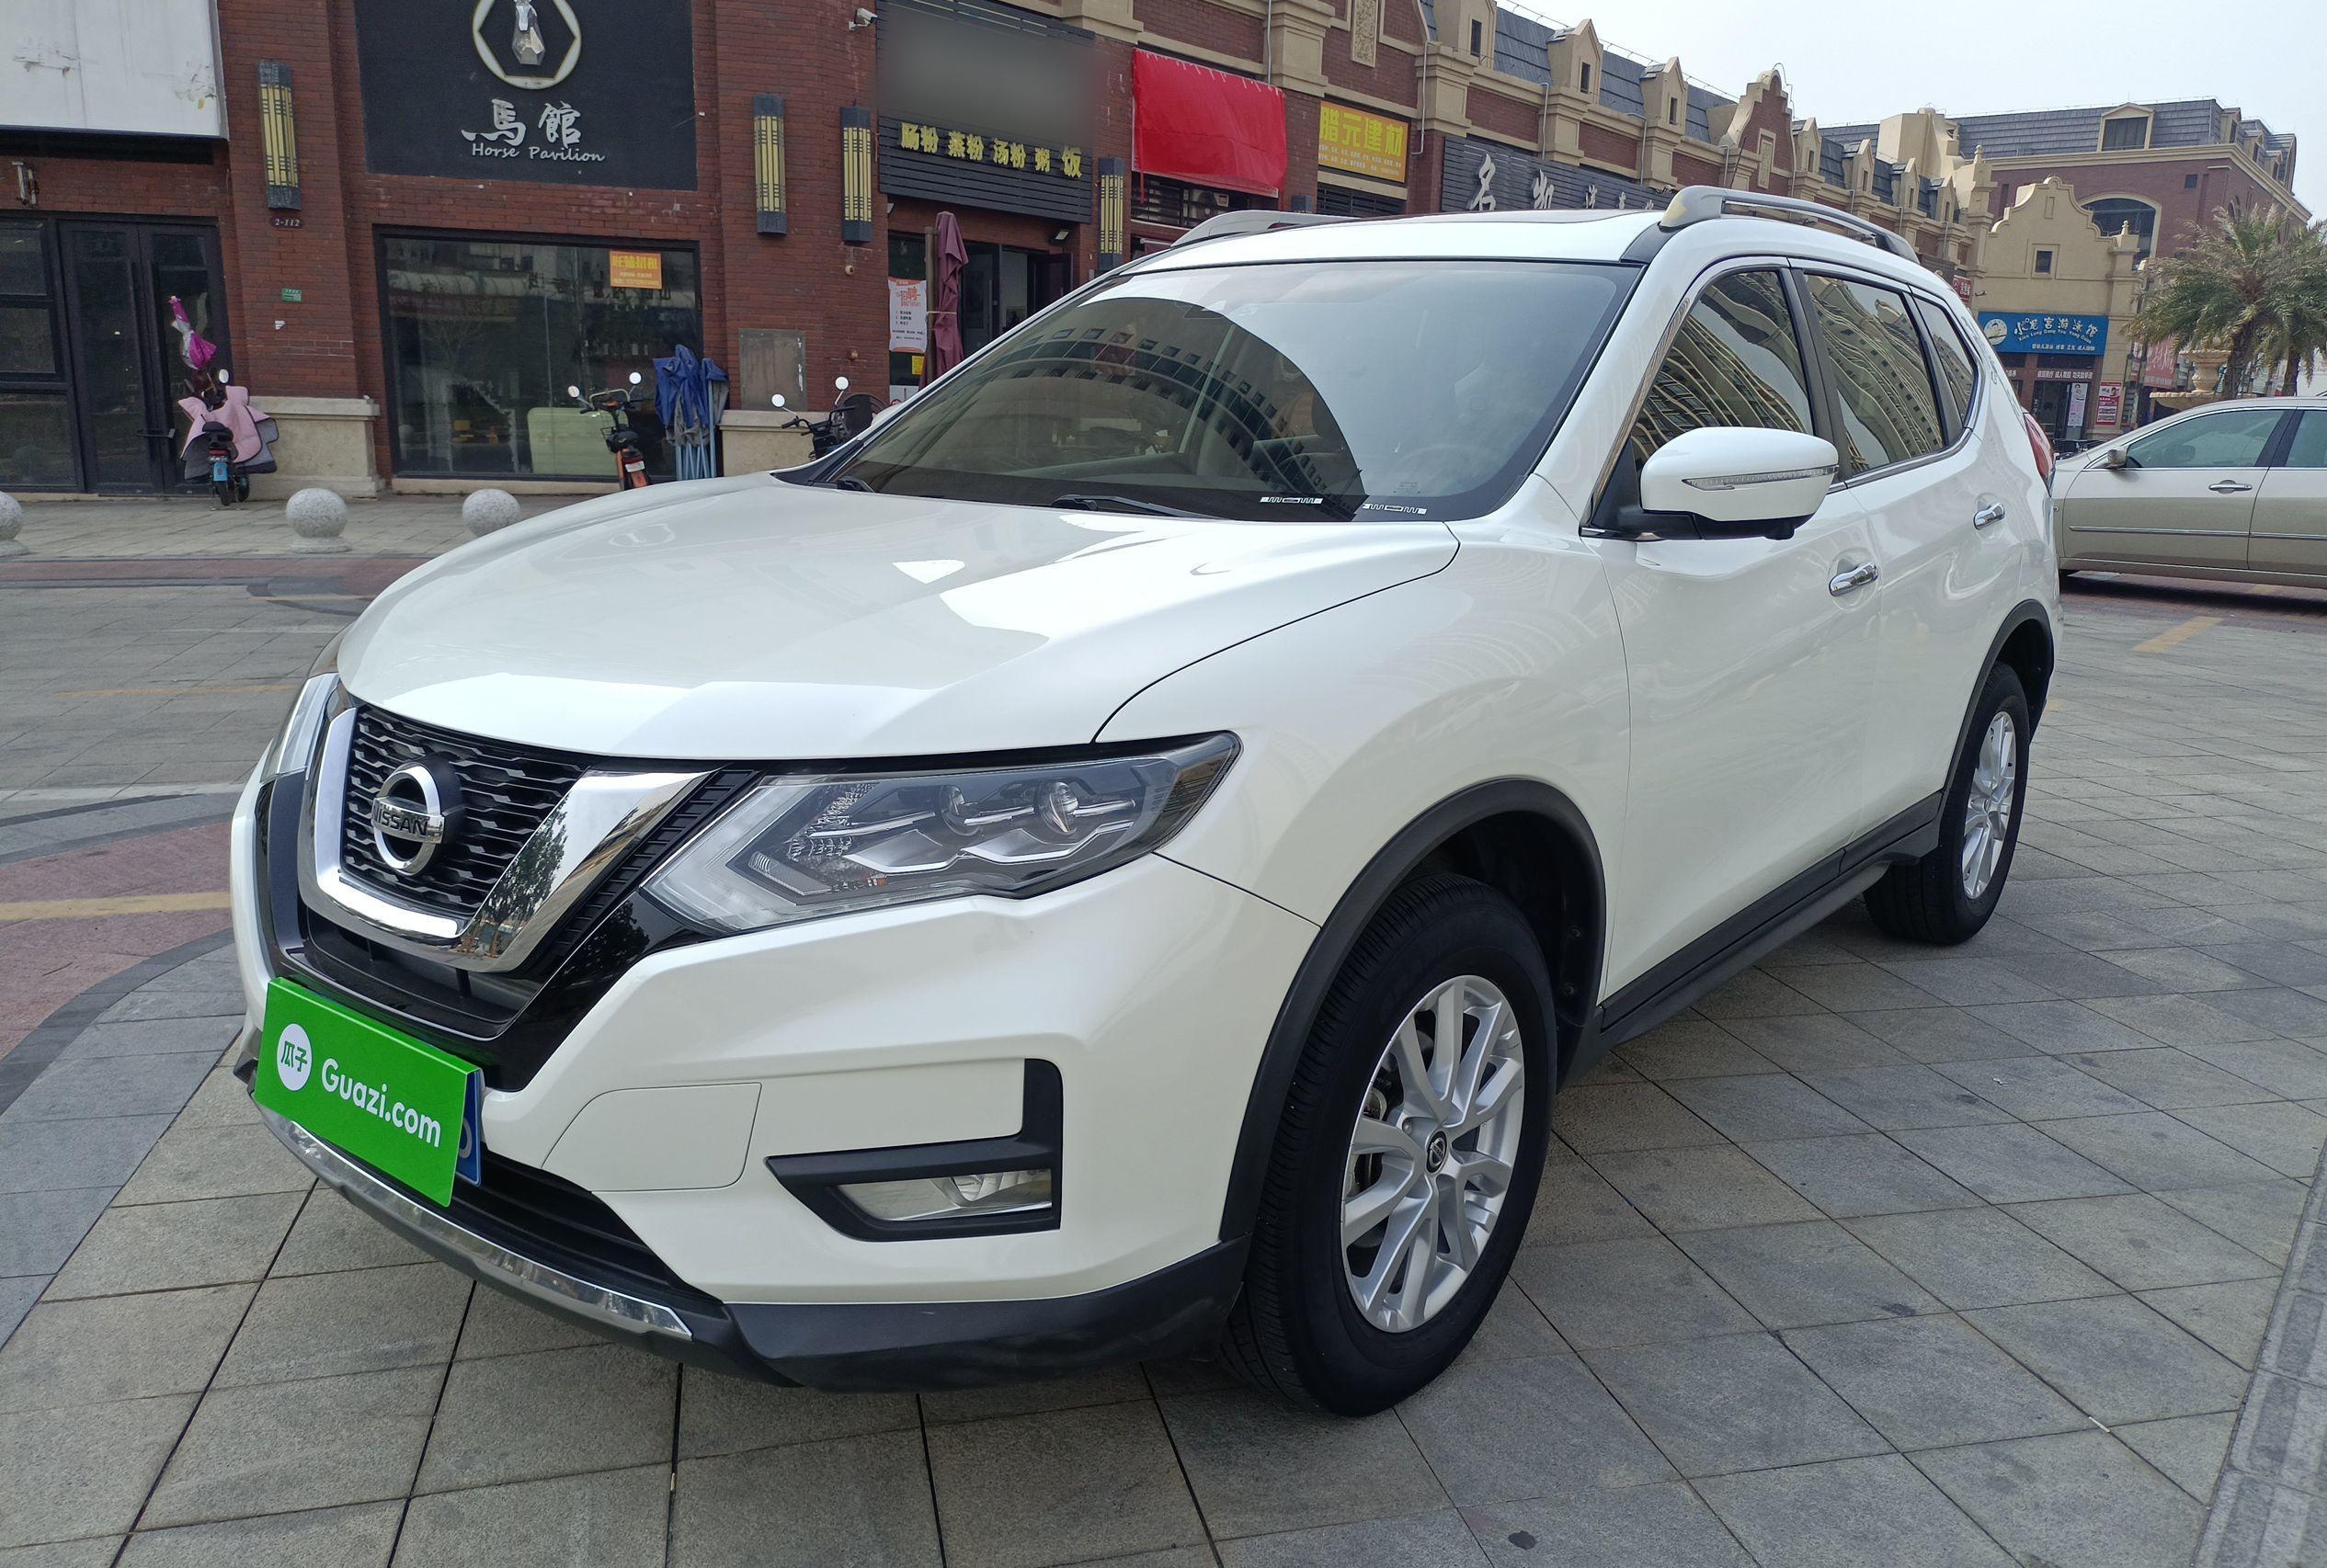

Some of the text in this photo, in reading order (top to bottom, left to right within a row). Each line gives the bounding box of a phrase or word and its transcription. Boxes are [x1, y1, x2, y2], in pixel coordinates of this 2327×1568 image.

[461, 97, 582, 149] 馬館
[472, 142, 606, 162] Horse Pavilion
[900, 121, 939, 153] 肠粉
[993, 137, 1026, 168] 汤粉
[1062, 145, 1082, 178] 饭
[275, 218, 300, 226] 2-112
[372, 801, 430, 837] NISSAN
[280, 1040, 308, 1073] 瓜子
[321, 1058, 441, 1148] Guazi.com
